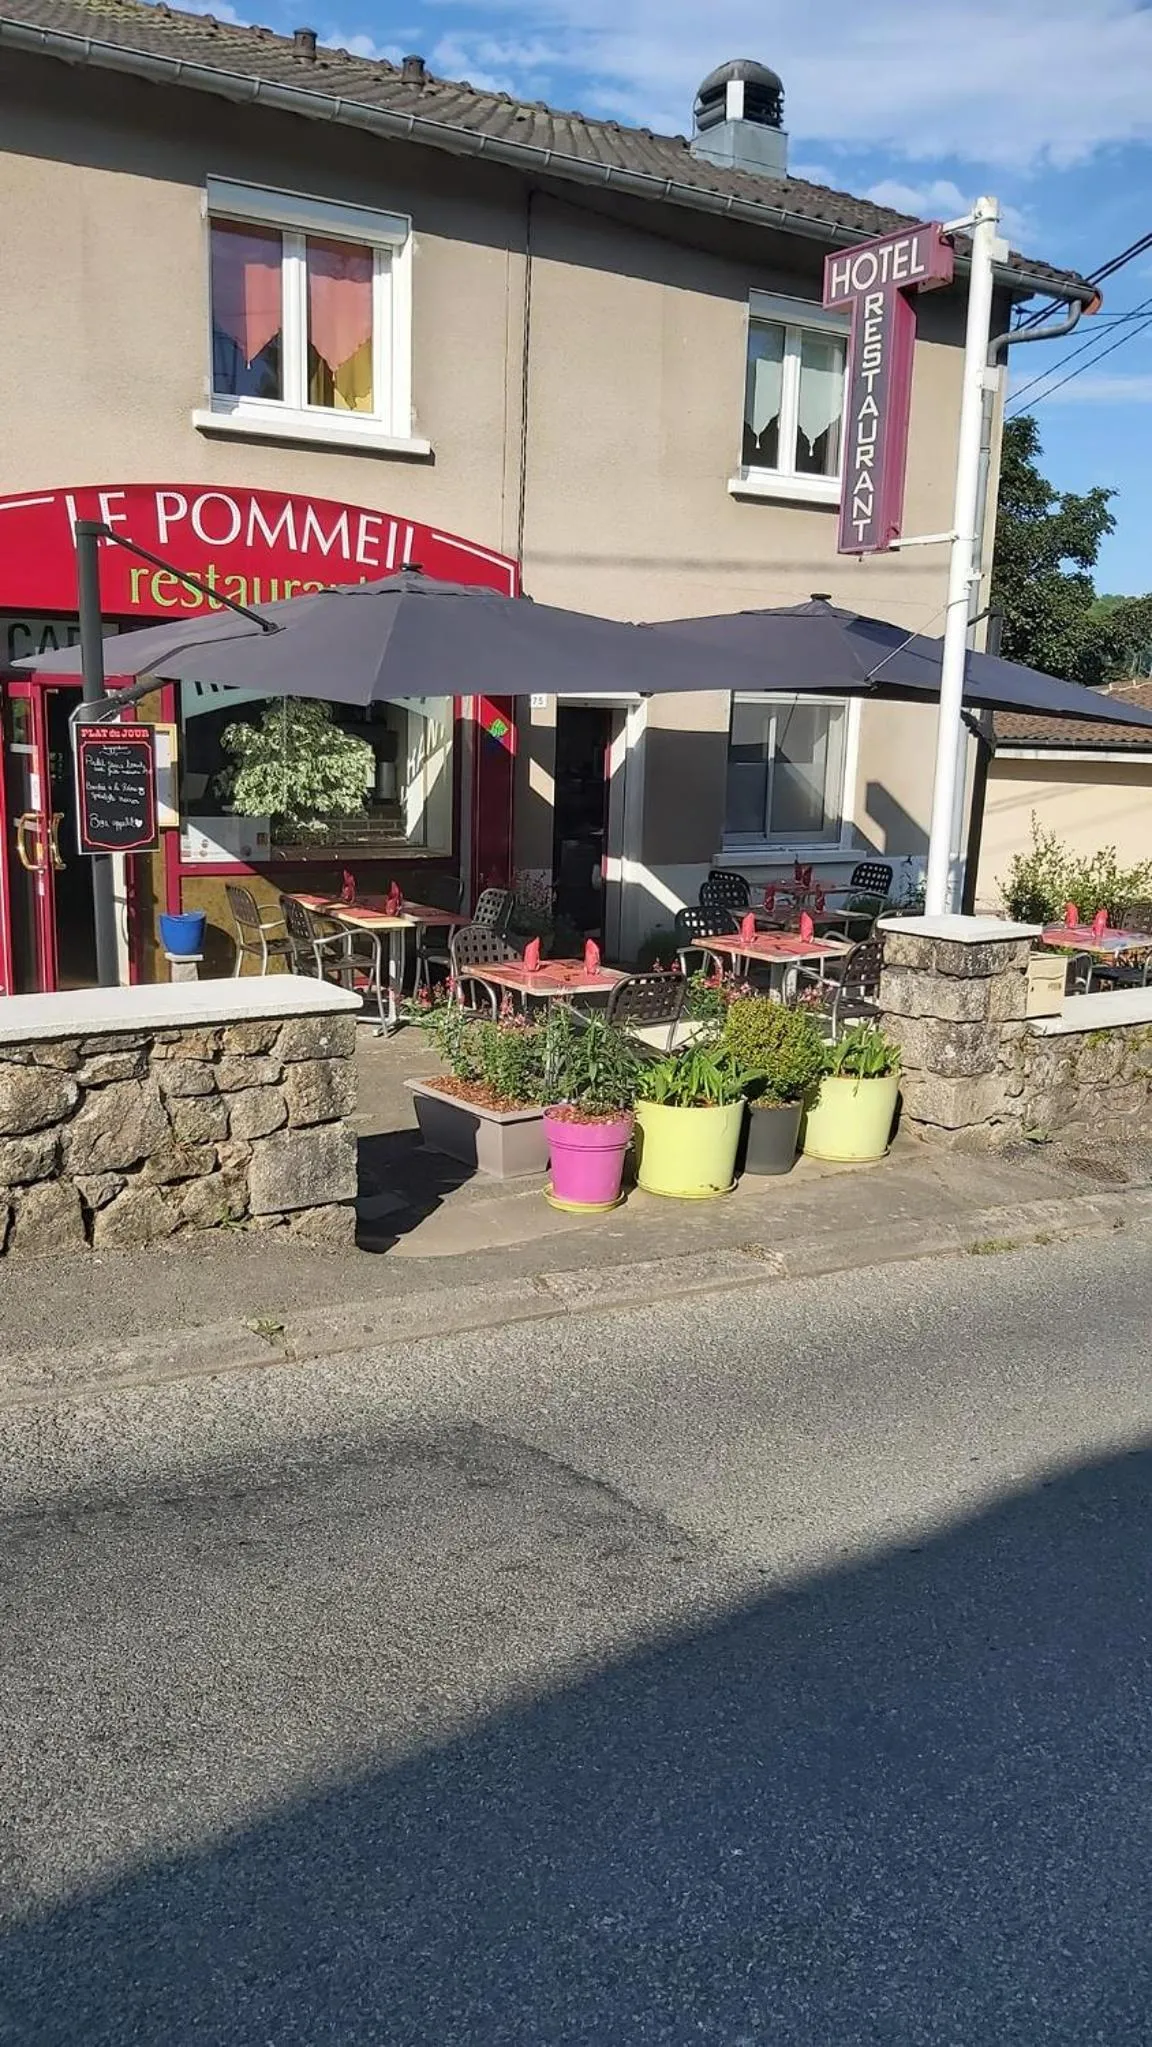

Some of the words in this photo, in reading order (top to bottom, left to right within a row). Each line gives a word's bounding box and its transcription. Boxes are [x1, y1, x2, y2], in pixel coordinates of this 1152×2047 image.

[831, 236, 925, 299] HOTEL
[852, 290, 884, 543] RESTAURANT
[65, 490, 132, 549] LE
[129, 563, 367, 611] restaur
[81, 728, 108, 738] PLAT
[109, 729, 120, 738] du
[122, 728, 149, 738] JOUR
